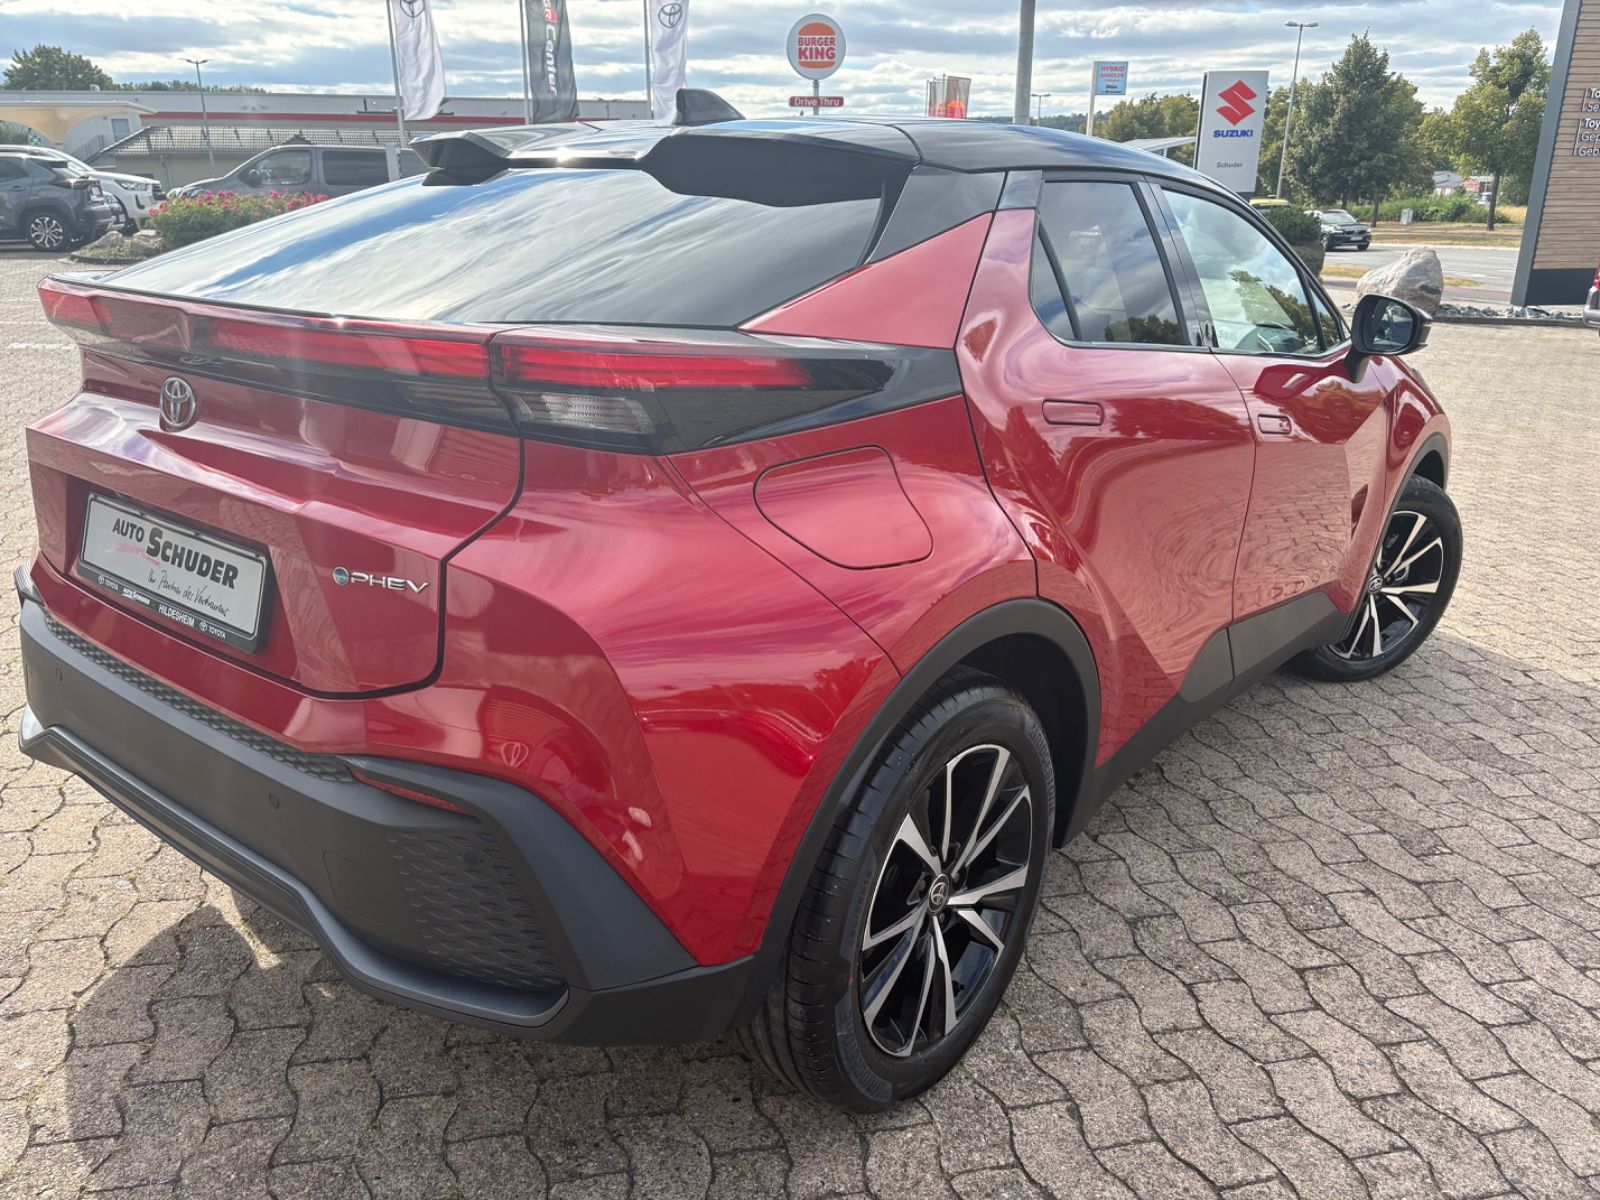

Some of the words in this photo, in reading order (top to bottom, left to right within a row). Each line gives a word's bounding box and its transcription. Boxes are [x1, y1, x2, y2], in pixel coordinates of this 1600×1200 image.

[798, 37, 835, 46] BURGER
[545, 24, 557, 96] Center
[798, 47, 835, 60] KING
[794, 97, 817, 106] Drive
[820, 97, 840, 106] Thru
[1213, 130, 1253, 138] SUZUKI
[112, 518, 145, 543] AUTO
[146, 527, 239, 589] SCHUDER
[351, 572, 428, 593] PHEV
[104, 579, 119, 590] TOYOTA
[158, 604, 195, 627] HILDESHEIM
[208, 626, 226, 639] TOYOTA
